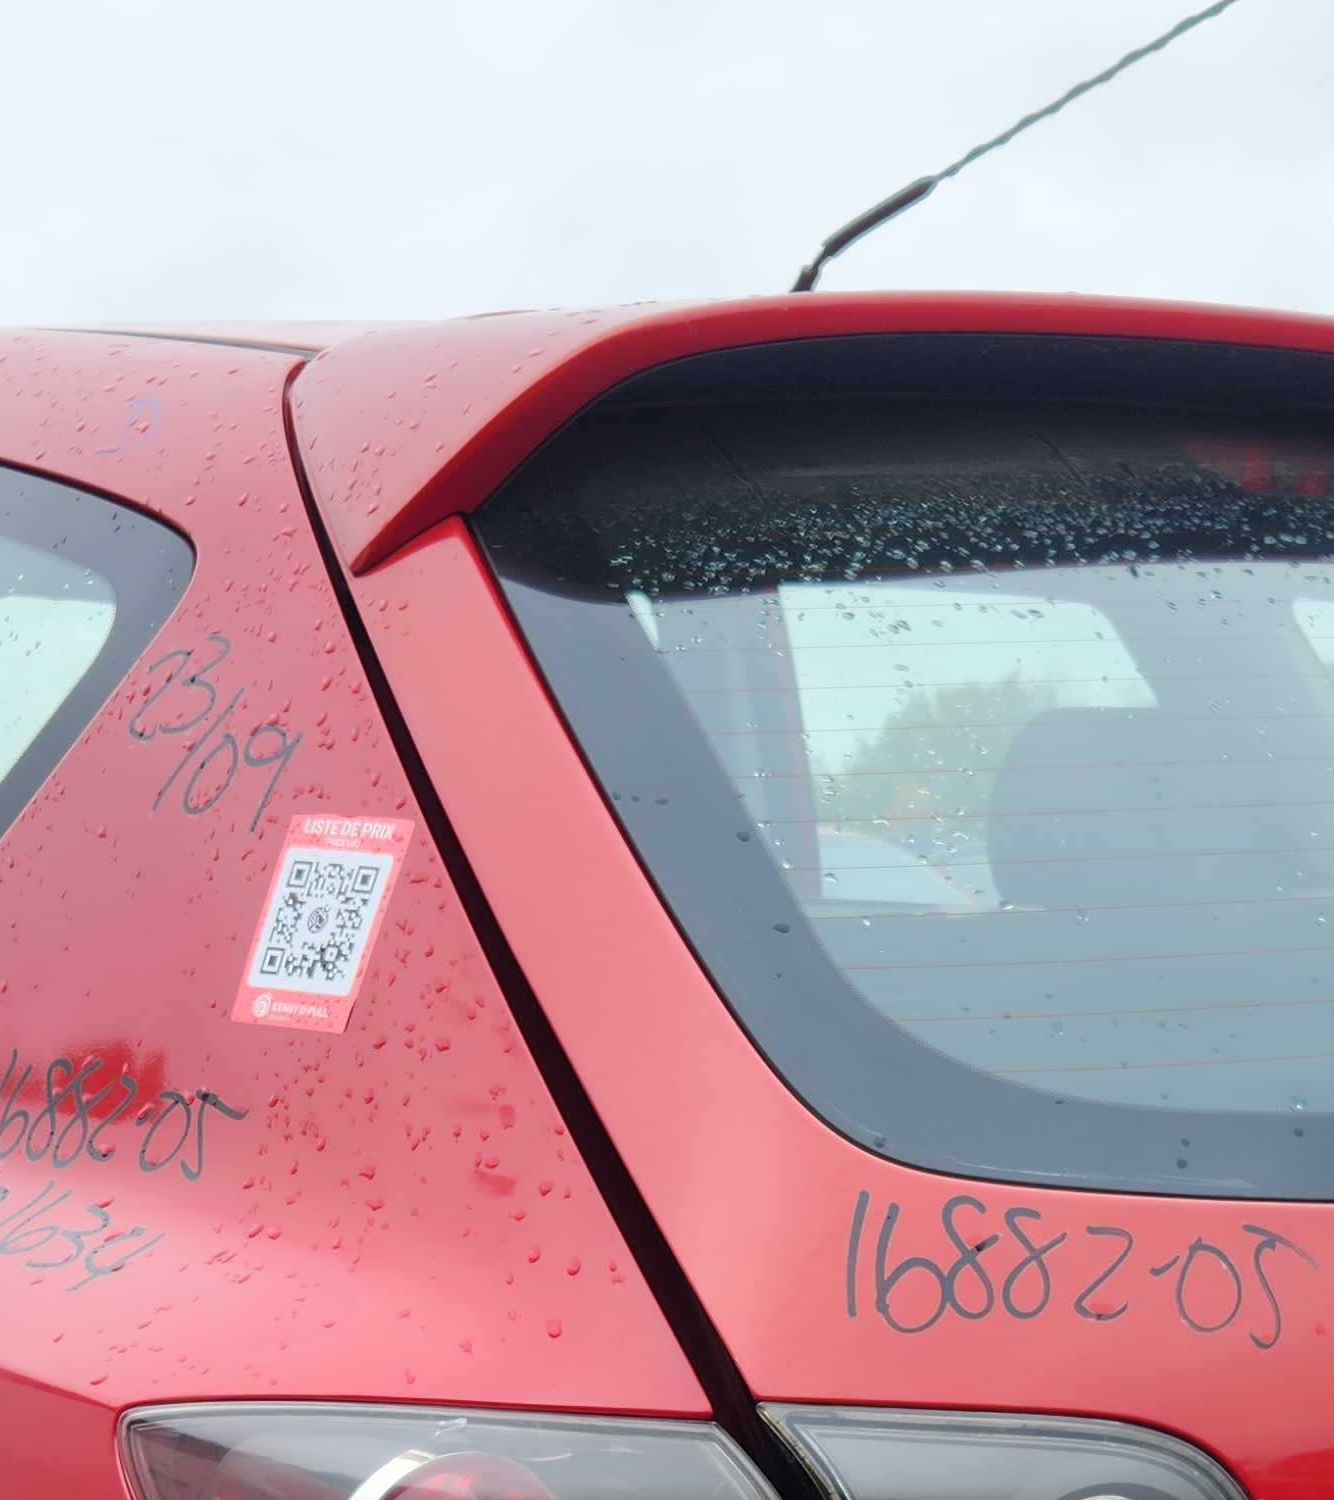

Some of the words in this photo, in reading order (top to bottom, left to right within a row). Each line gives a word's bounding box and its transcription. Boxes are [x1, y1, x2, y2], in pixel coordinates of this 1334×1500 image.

[304, 817, 341, 836] LISTE
[340, 820, 361, 837] DE
[361, 822, 397, 840] PRIX
